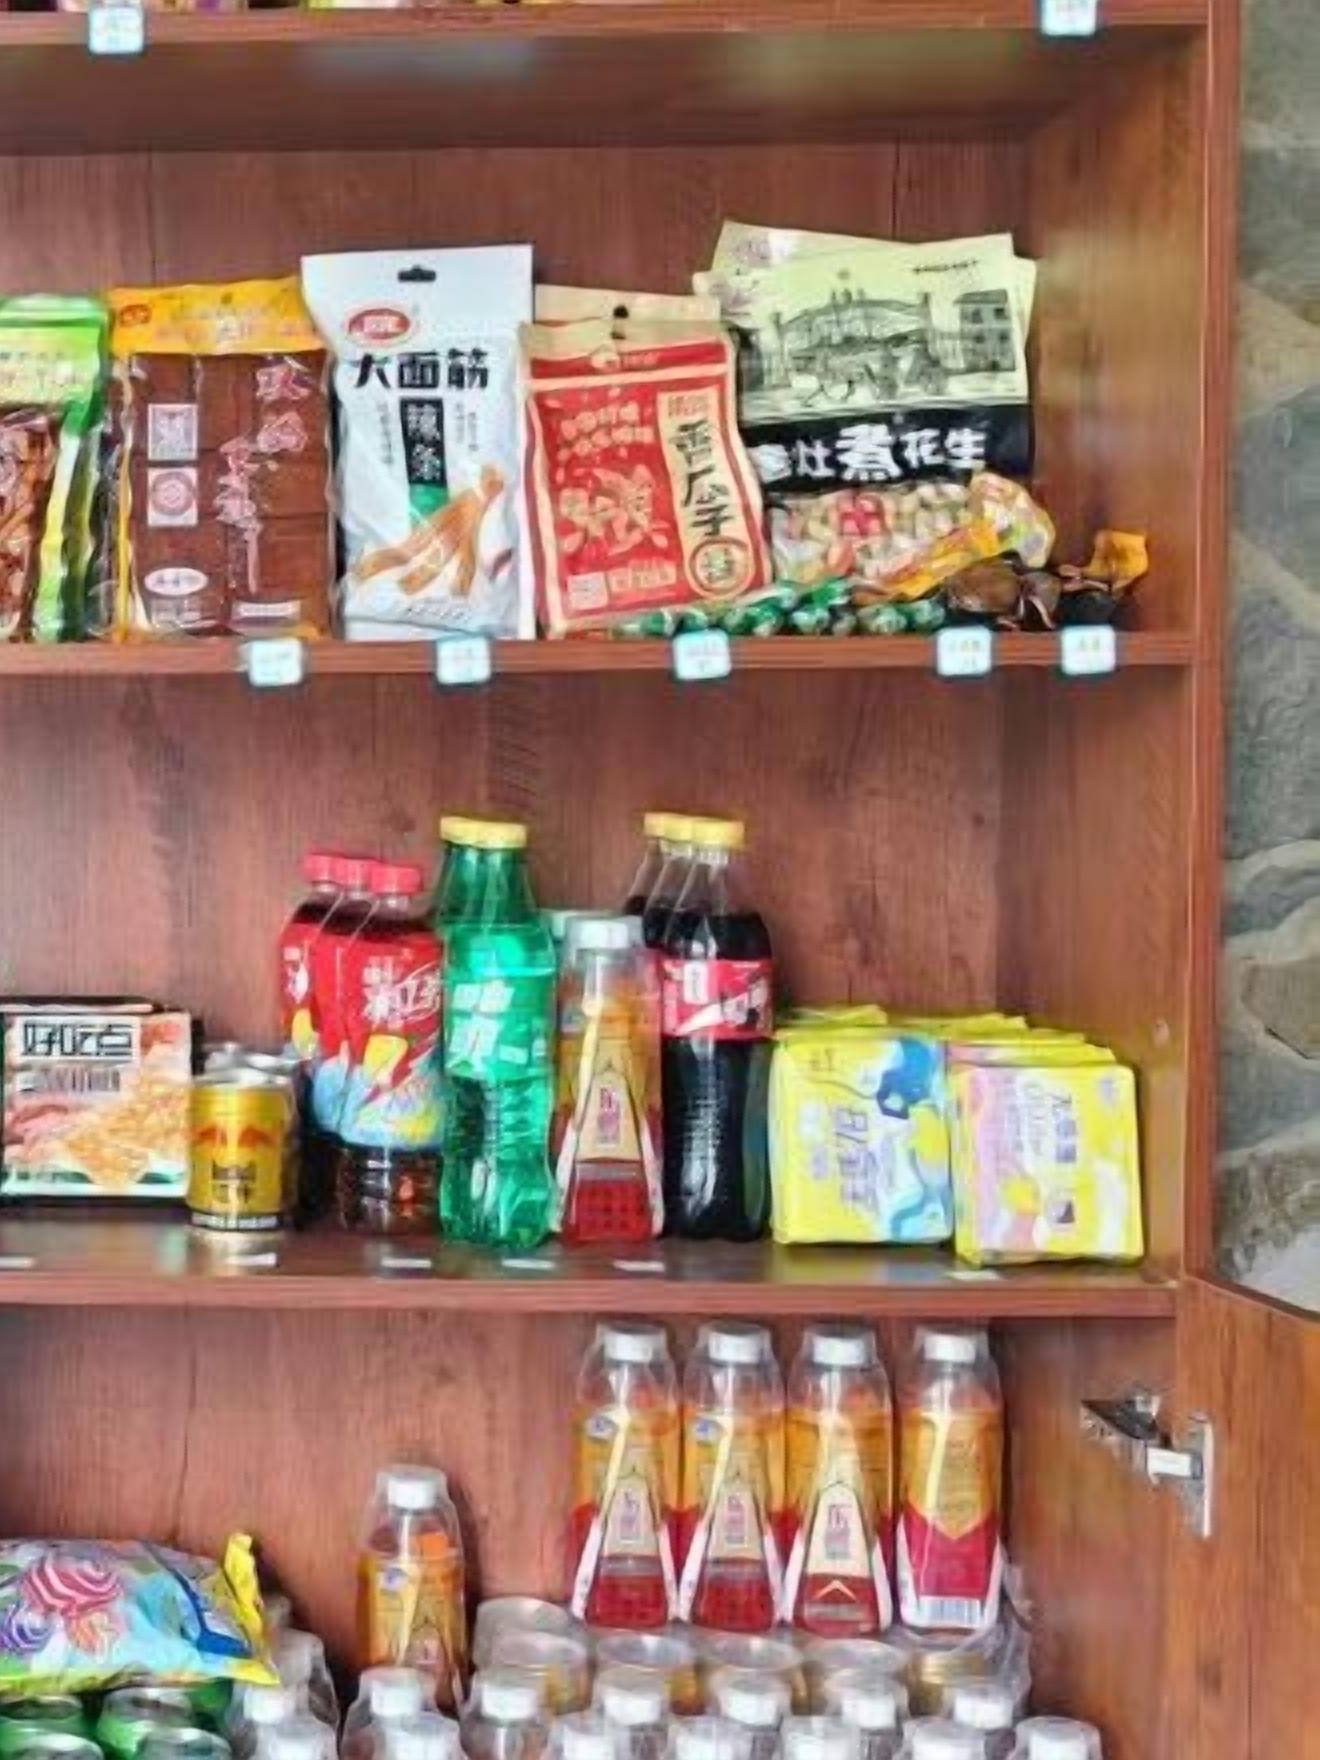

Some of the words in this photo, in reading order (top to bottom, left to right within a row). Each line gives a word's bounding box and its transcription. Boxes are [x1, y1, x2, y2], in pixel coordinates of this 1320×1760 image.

[354, 348, 488, 390] 大面筋
[22, 1022, 132, 1057] 好吃点
